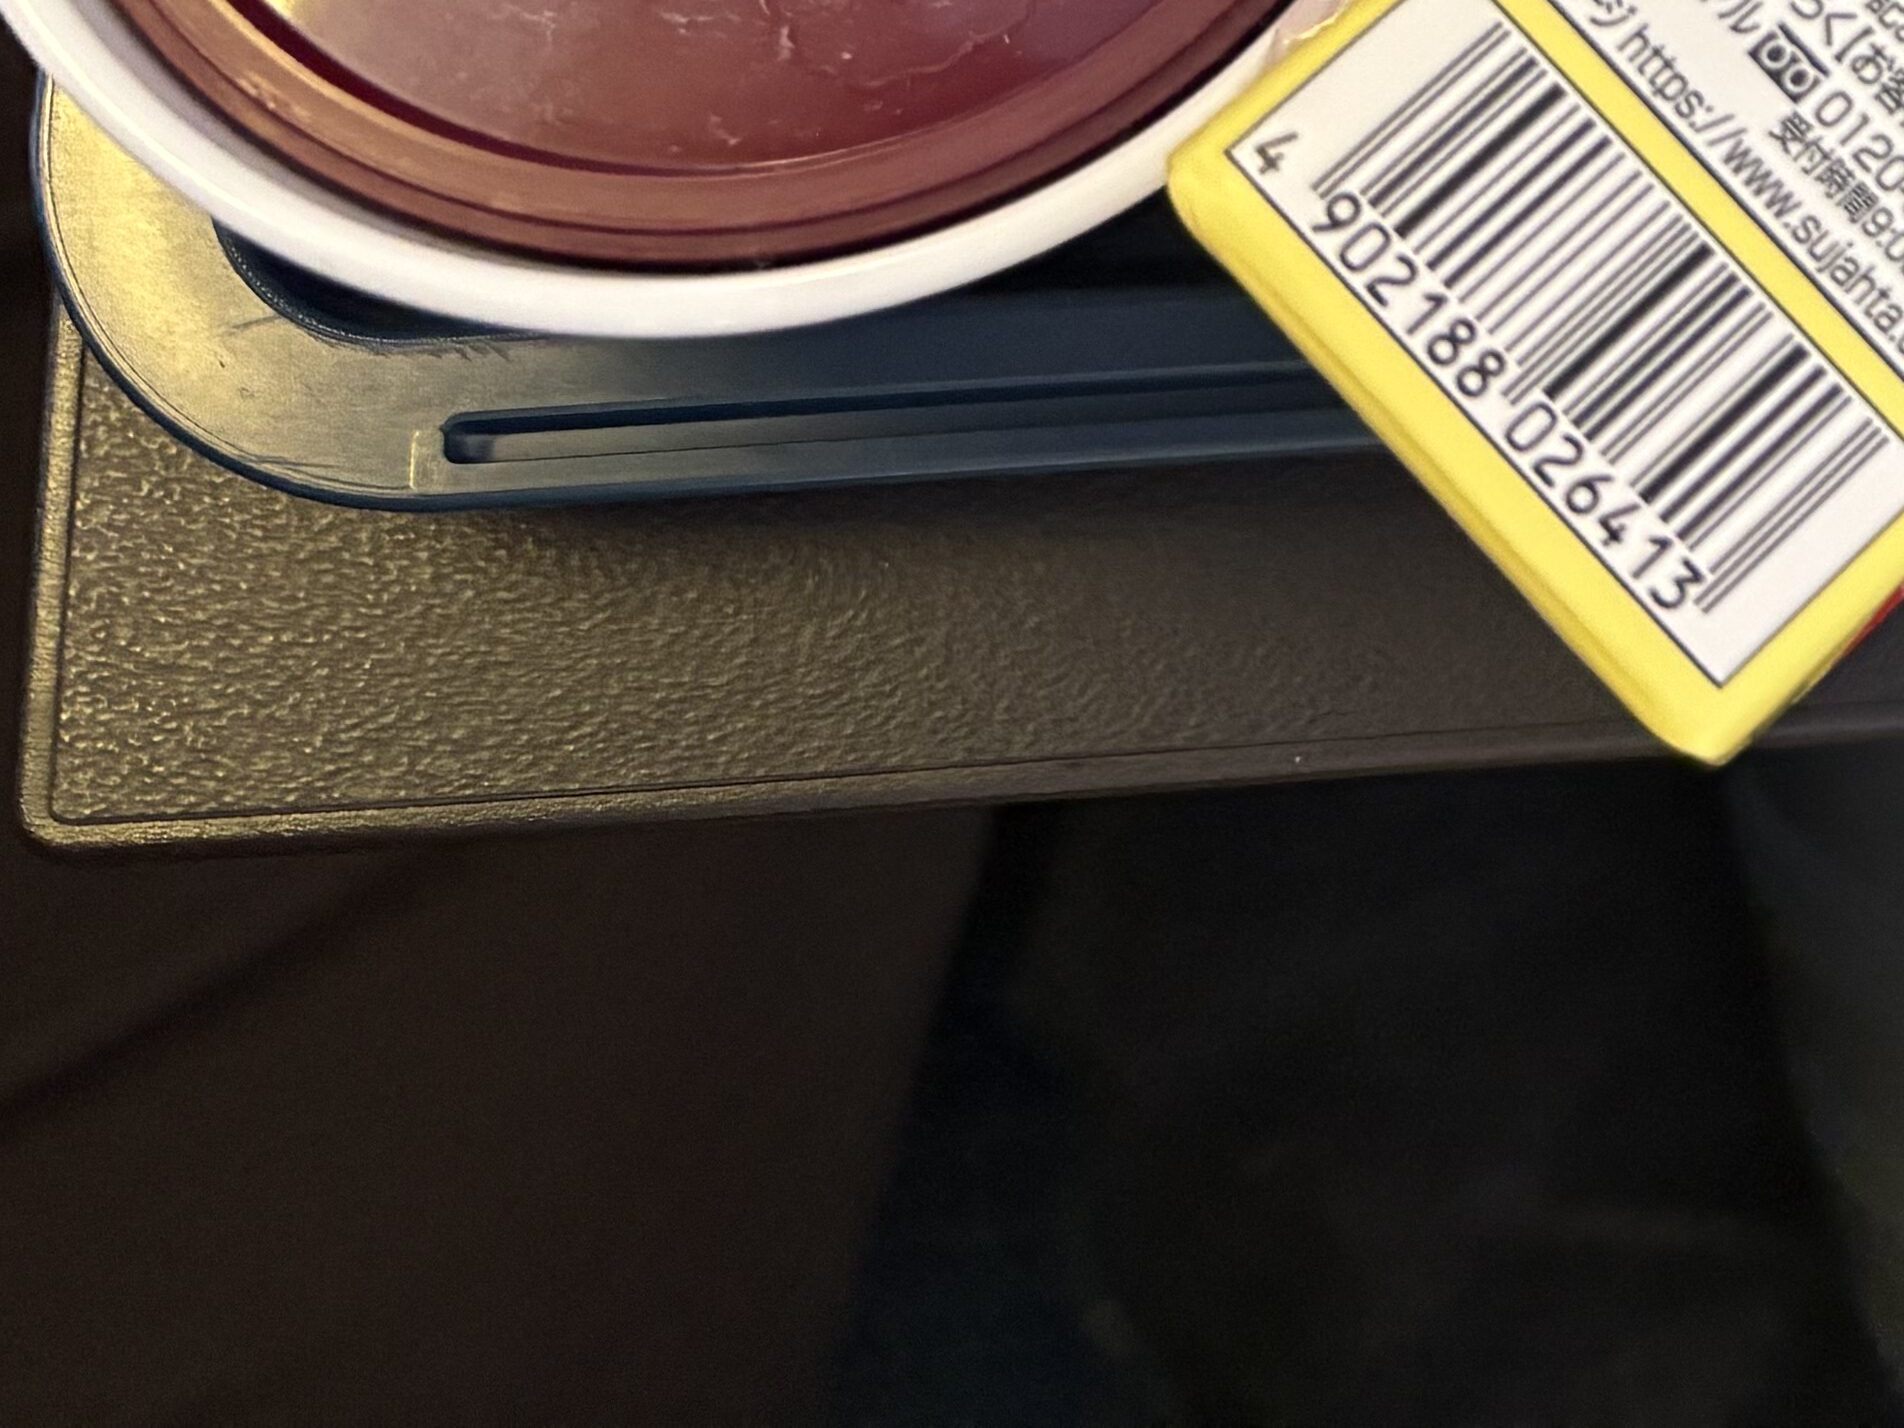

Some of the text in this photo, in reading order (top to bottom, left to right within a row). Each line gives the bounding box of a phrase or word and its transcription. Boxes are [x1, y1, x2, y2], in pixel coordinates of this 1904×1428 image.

[1254, 131, 1706, 611] 4 902188 026413
